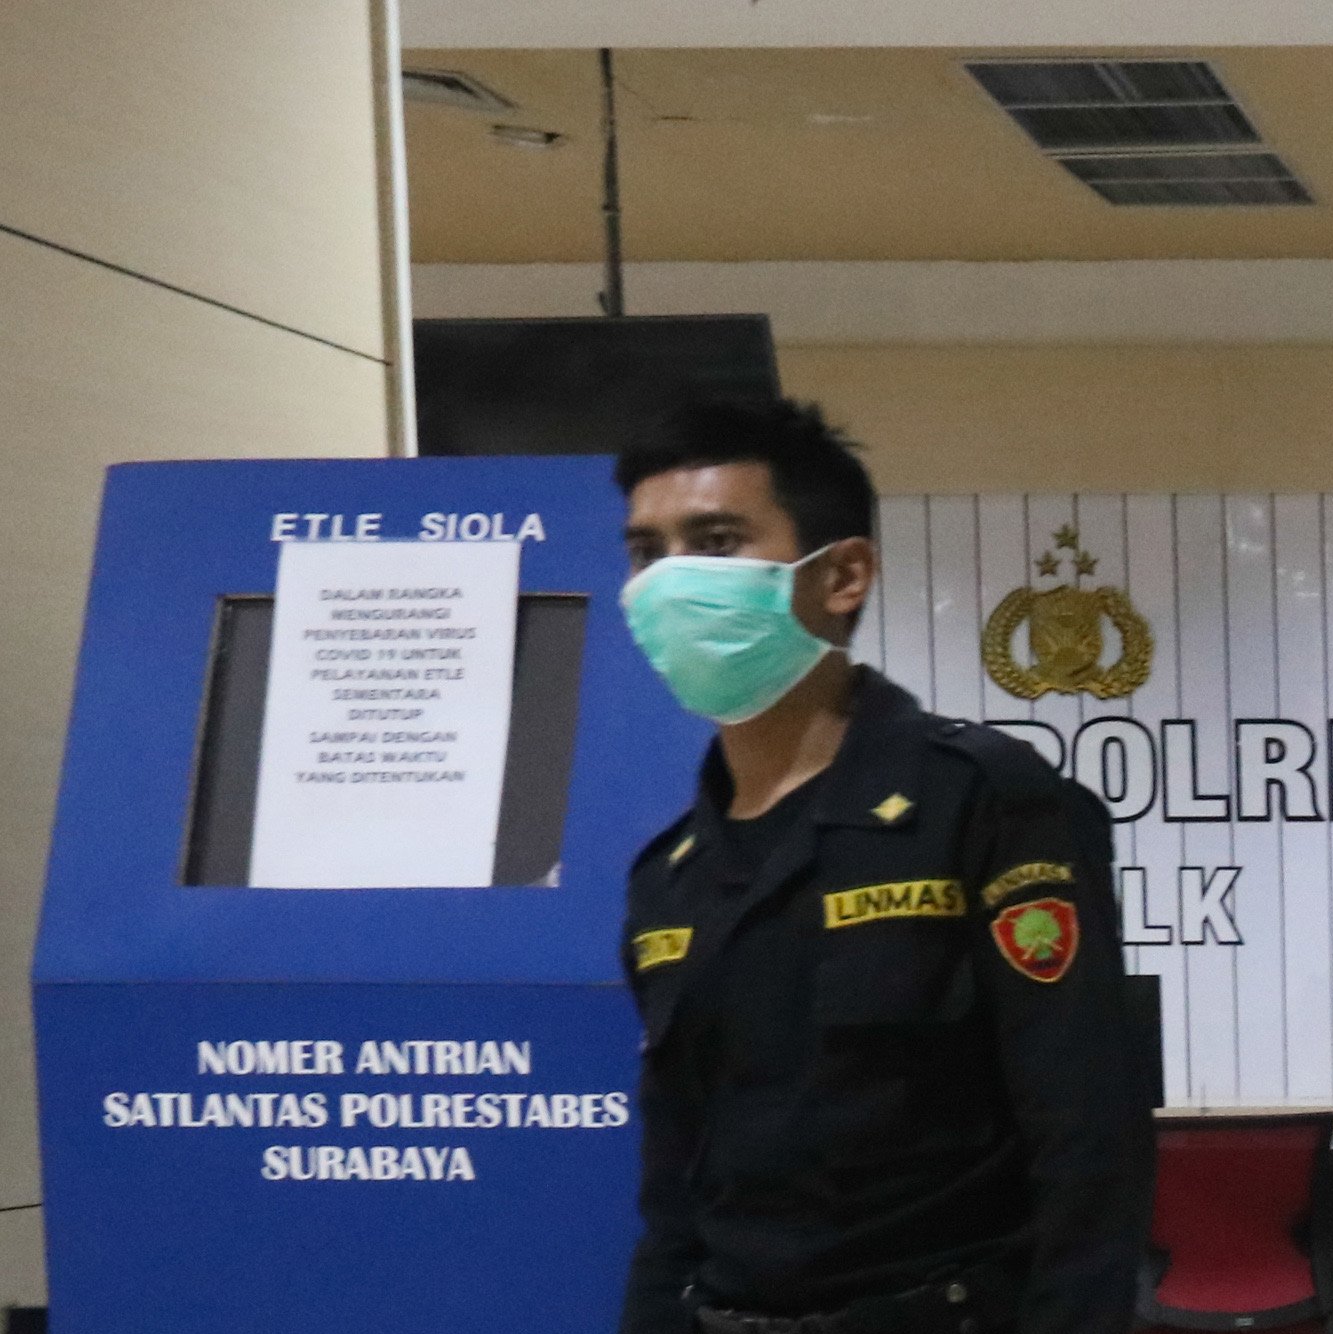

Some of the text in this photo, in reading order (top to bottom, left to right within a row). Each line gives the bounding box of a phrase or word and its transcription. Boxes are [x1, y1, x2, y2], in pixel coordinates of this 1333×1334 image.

[270, 512, 547, 543] ETLE SIOLA
[318, 587, 463, 601] DALAM RANGKA
[331, 607, 452, 621] MENGURANGI
[303, 626, 477, 641] PENYEBARAN VIRUS
[314, 648, 372, 661] COVID
[401, 648, 462, 661] UNTUK
[310, 667, 466, 682] PELAYANAN ETLE
[331, 687, 442, 701] SEMENTARA
[347, 708, 424, 721] DITUTUP
[308, 730, 458, 744] SAMPAI DENGAN
[317, 751, 448, 764] BATAS WAKTU
[294, 770, 467, 784] YANG DITENTUKAN
[833, 884, 959, 921] LINMAS
[198, 1040, 531, 1076] NOMER ANTRIAN
[102, 1092, 630, 1128] SATLANTAS POLRESTABES
[260, 1145, 476, 1181] SURABAYA
